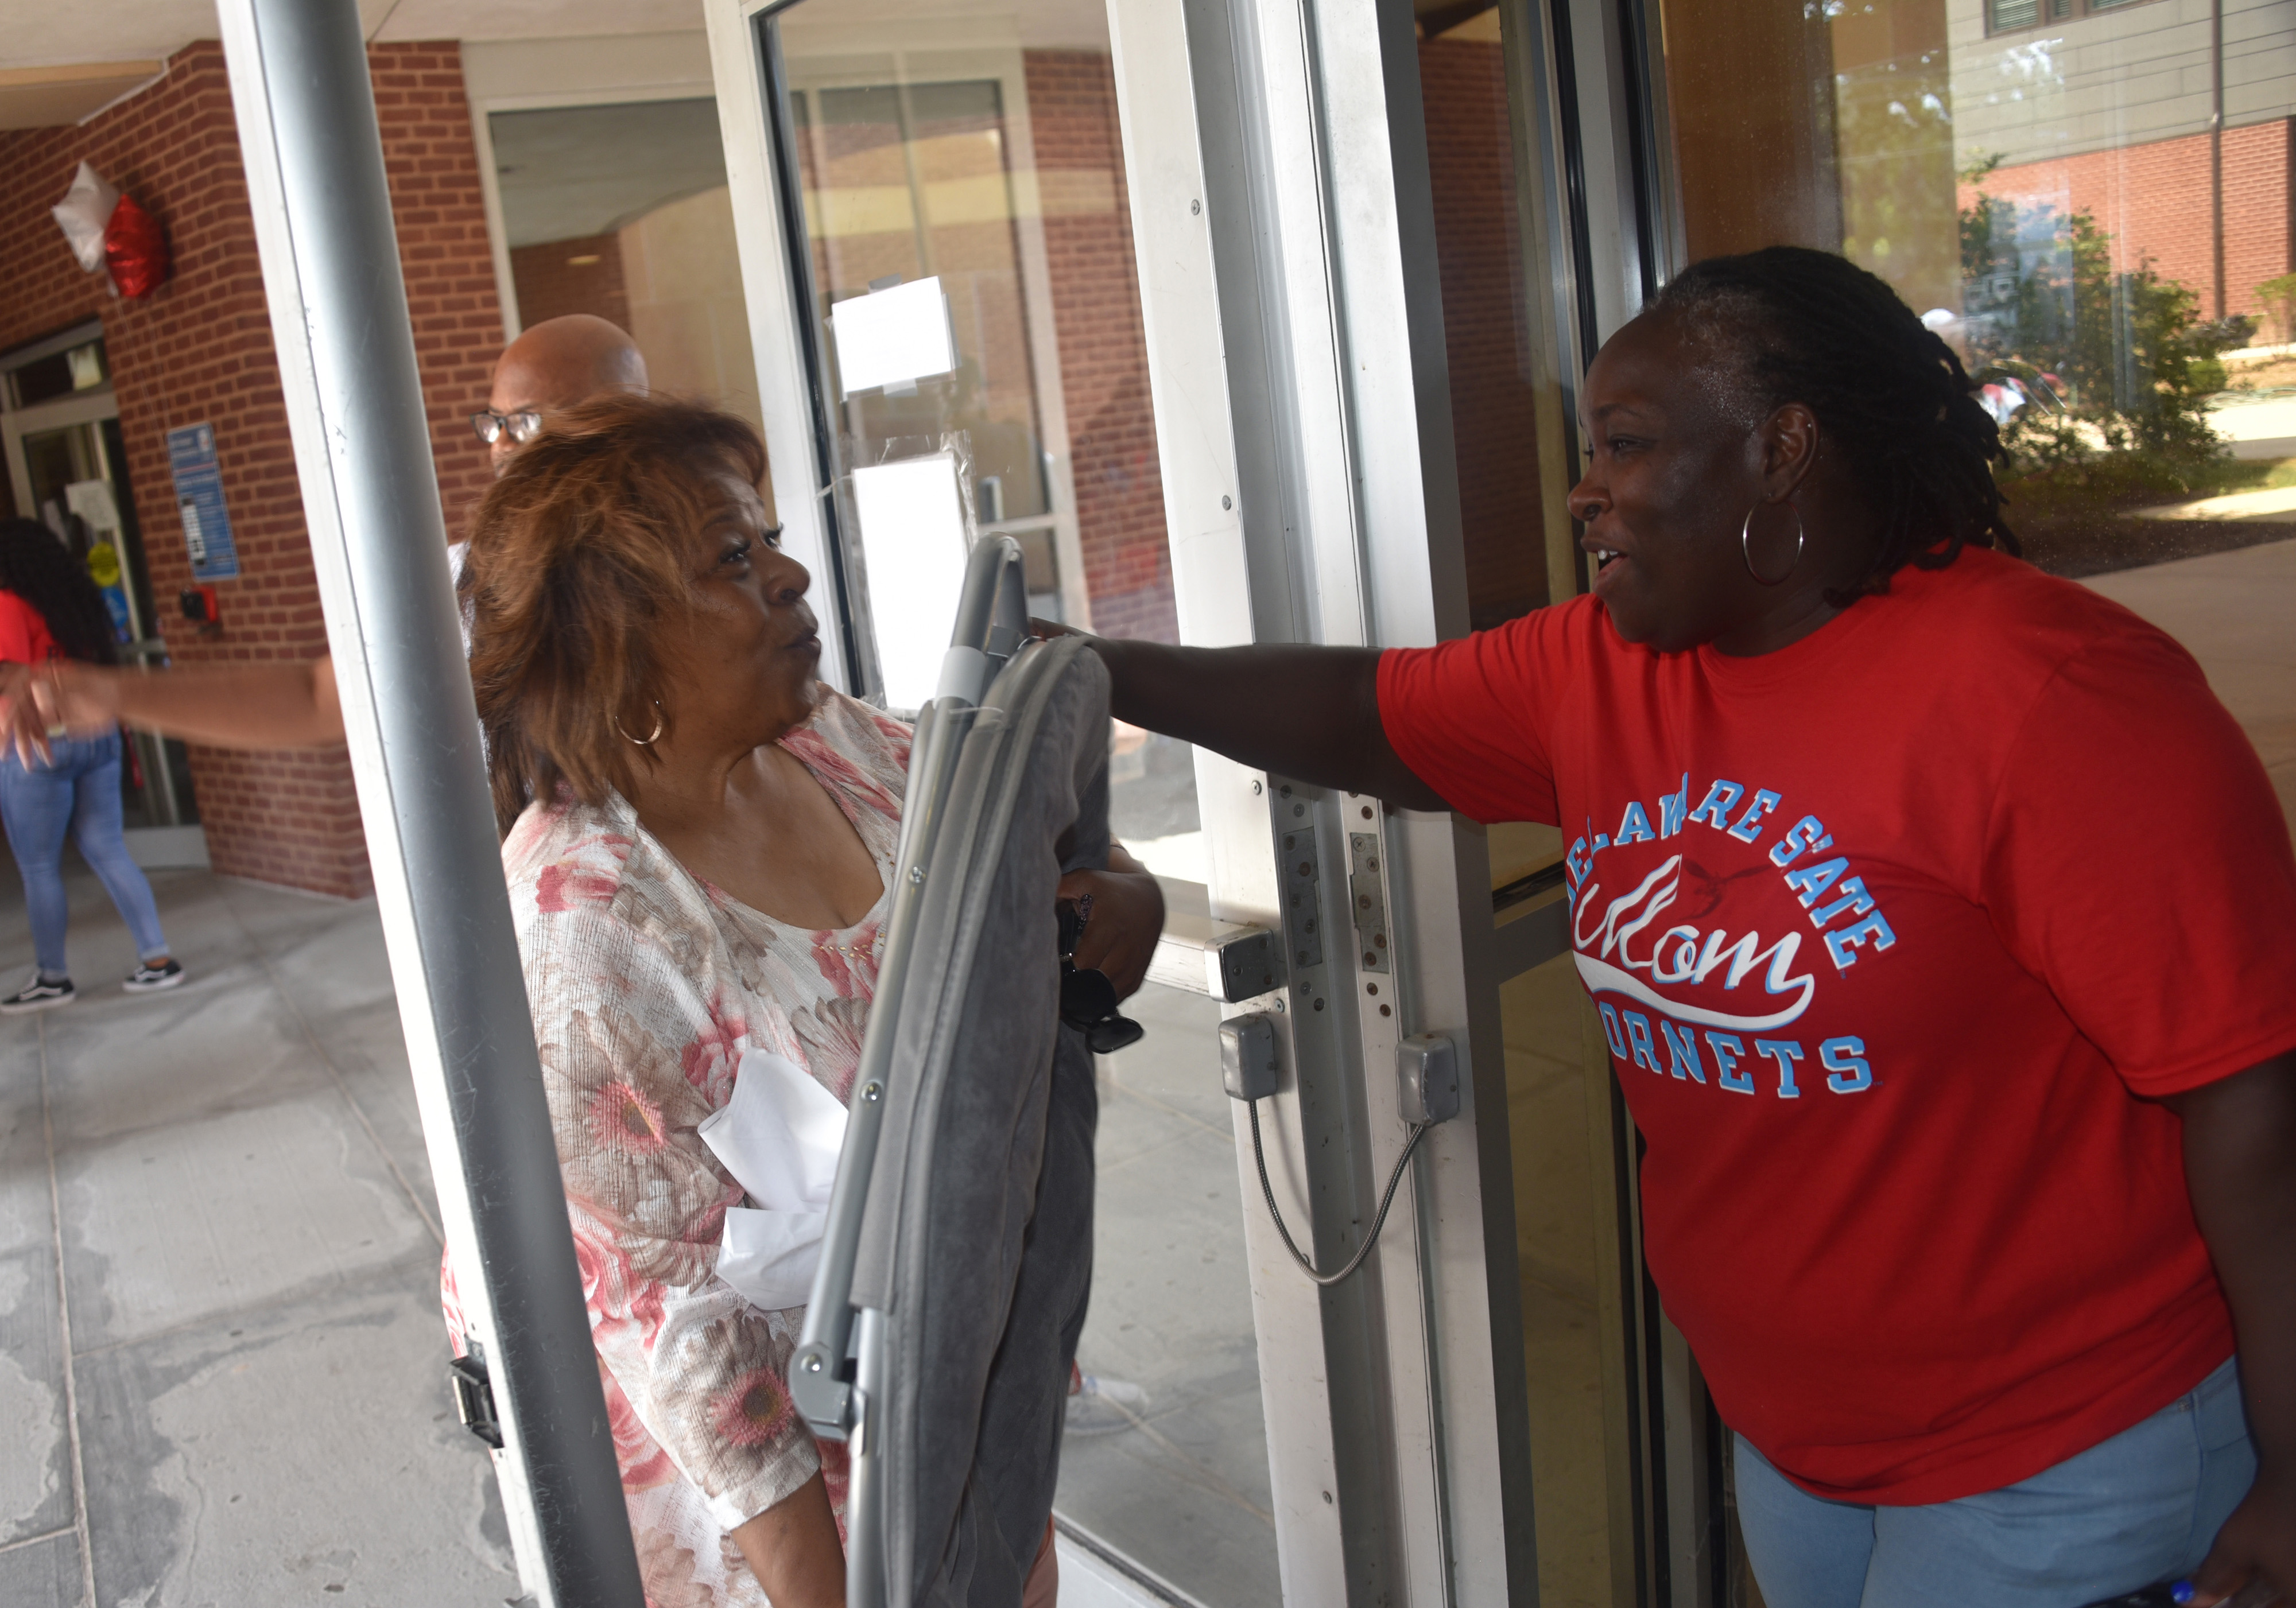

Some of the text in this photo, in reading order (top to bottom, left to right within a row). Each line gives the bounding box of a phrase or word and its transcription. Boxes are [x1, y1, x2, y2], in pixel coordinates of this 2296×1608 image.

[1574, 853, 1815, 995] Mom
[1768, 814, 1896, 970] SATE
[1588, 993, 1873, 1099] ORNETS
